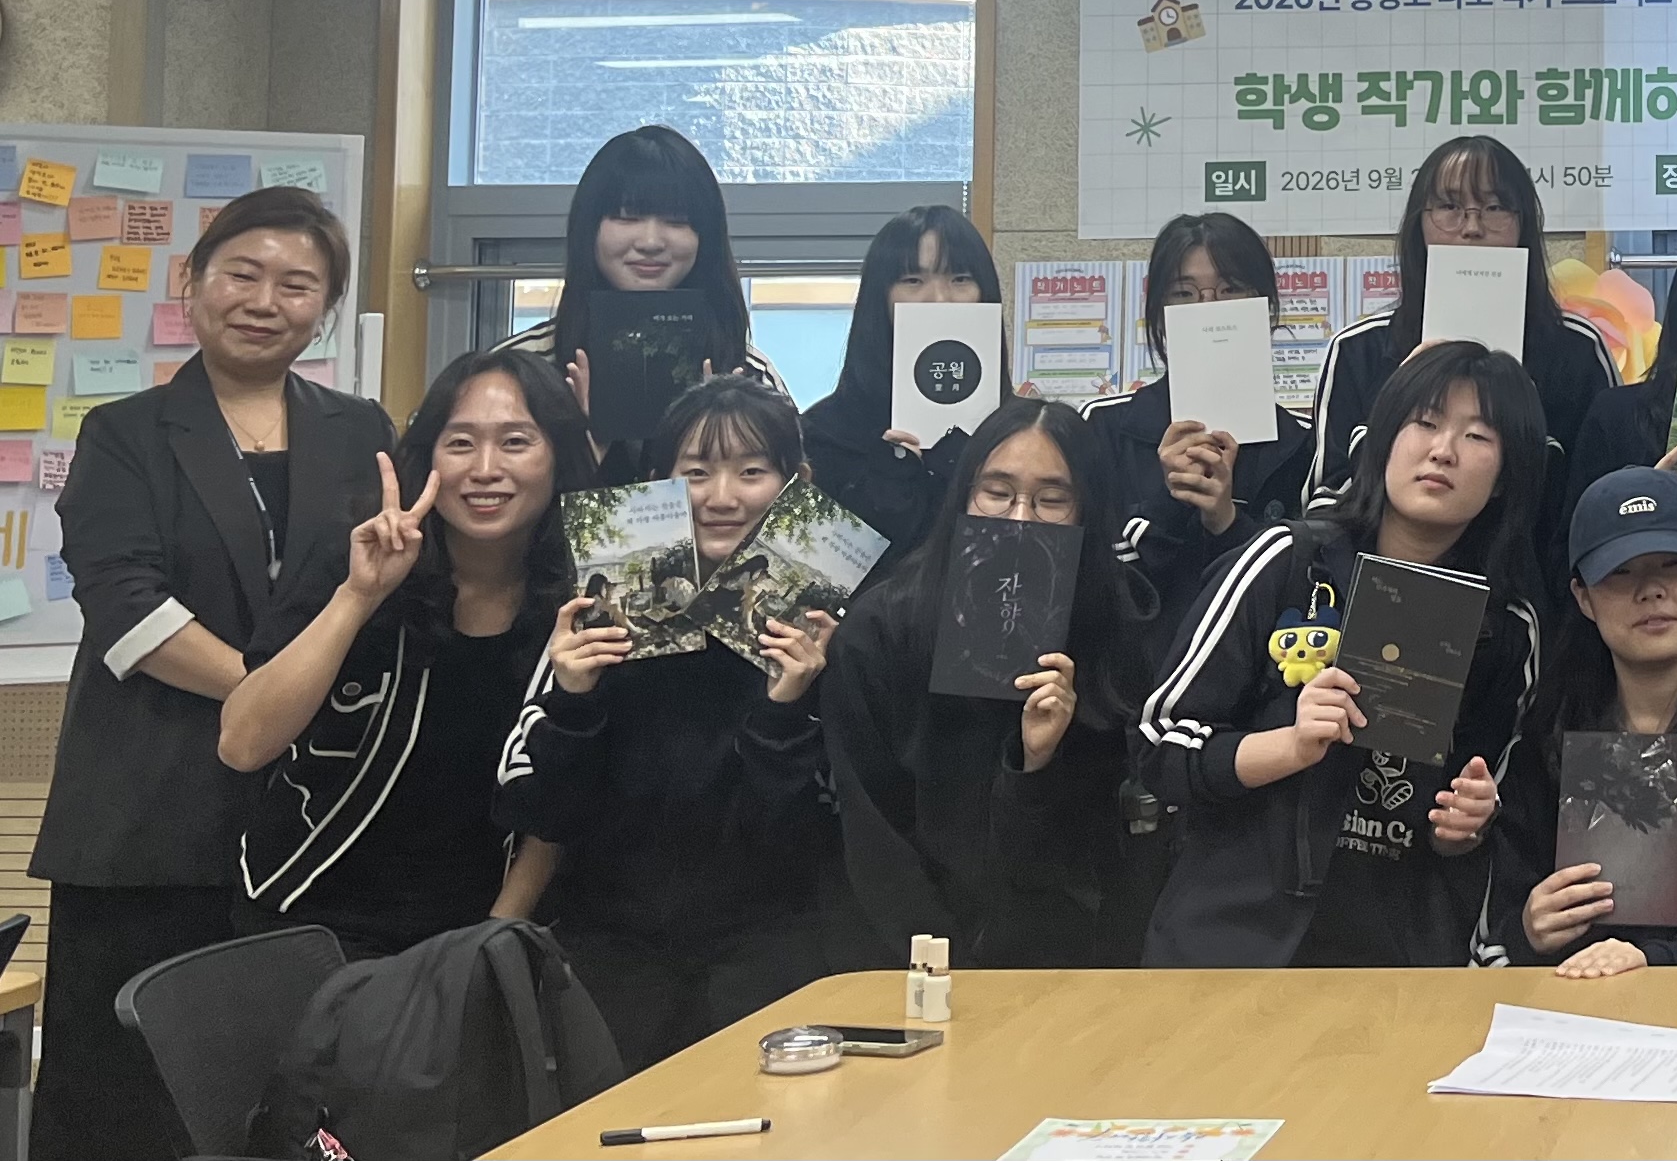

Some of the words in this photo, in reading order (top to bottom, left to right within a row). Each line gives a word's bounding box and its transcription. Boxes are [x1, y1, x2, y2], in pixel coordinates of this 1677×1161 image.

[1234, 72, 1343, 132] 학생
[1356, 69, 1525, 128] 작가와
[1211, 169, 1256, 196] 일시
[1280, 168, 1361, 191] 2026년
[1367, 167, 1403, 191] 9월
[1527, 164, 1555, 189] 시
[1562, 164, 1614, 188] 50분
[928, 361, 965, 380] 공월
[1619, 499, 1656, 515] emis
[995, 573, 1023, 637] 잔향
